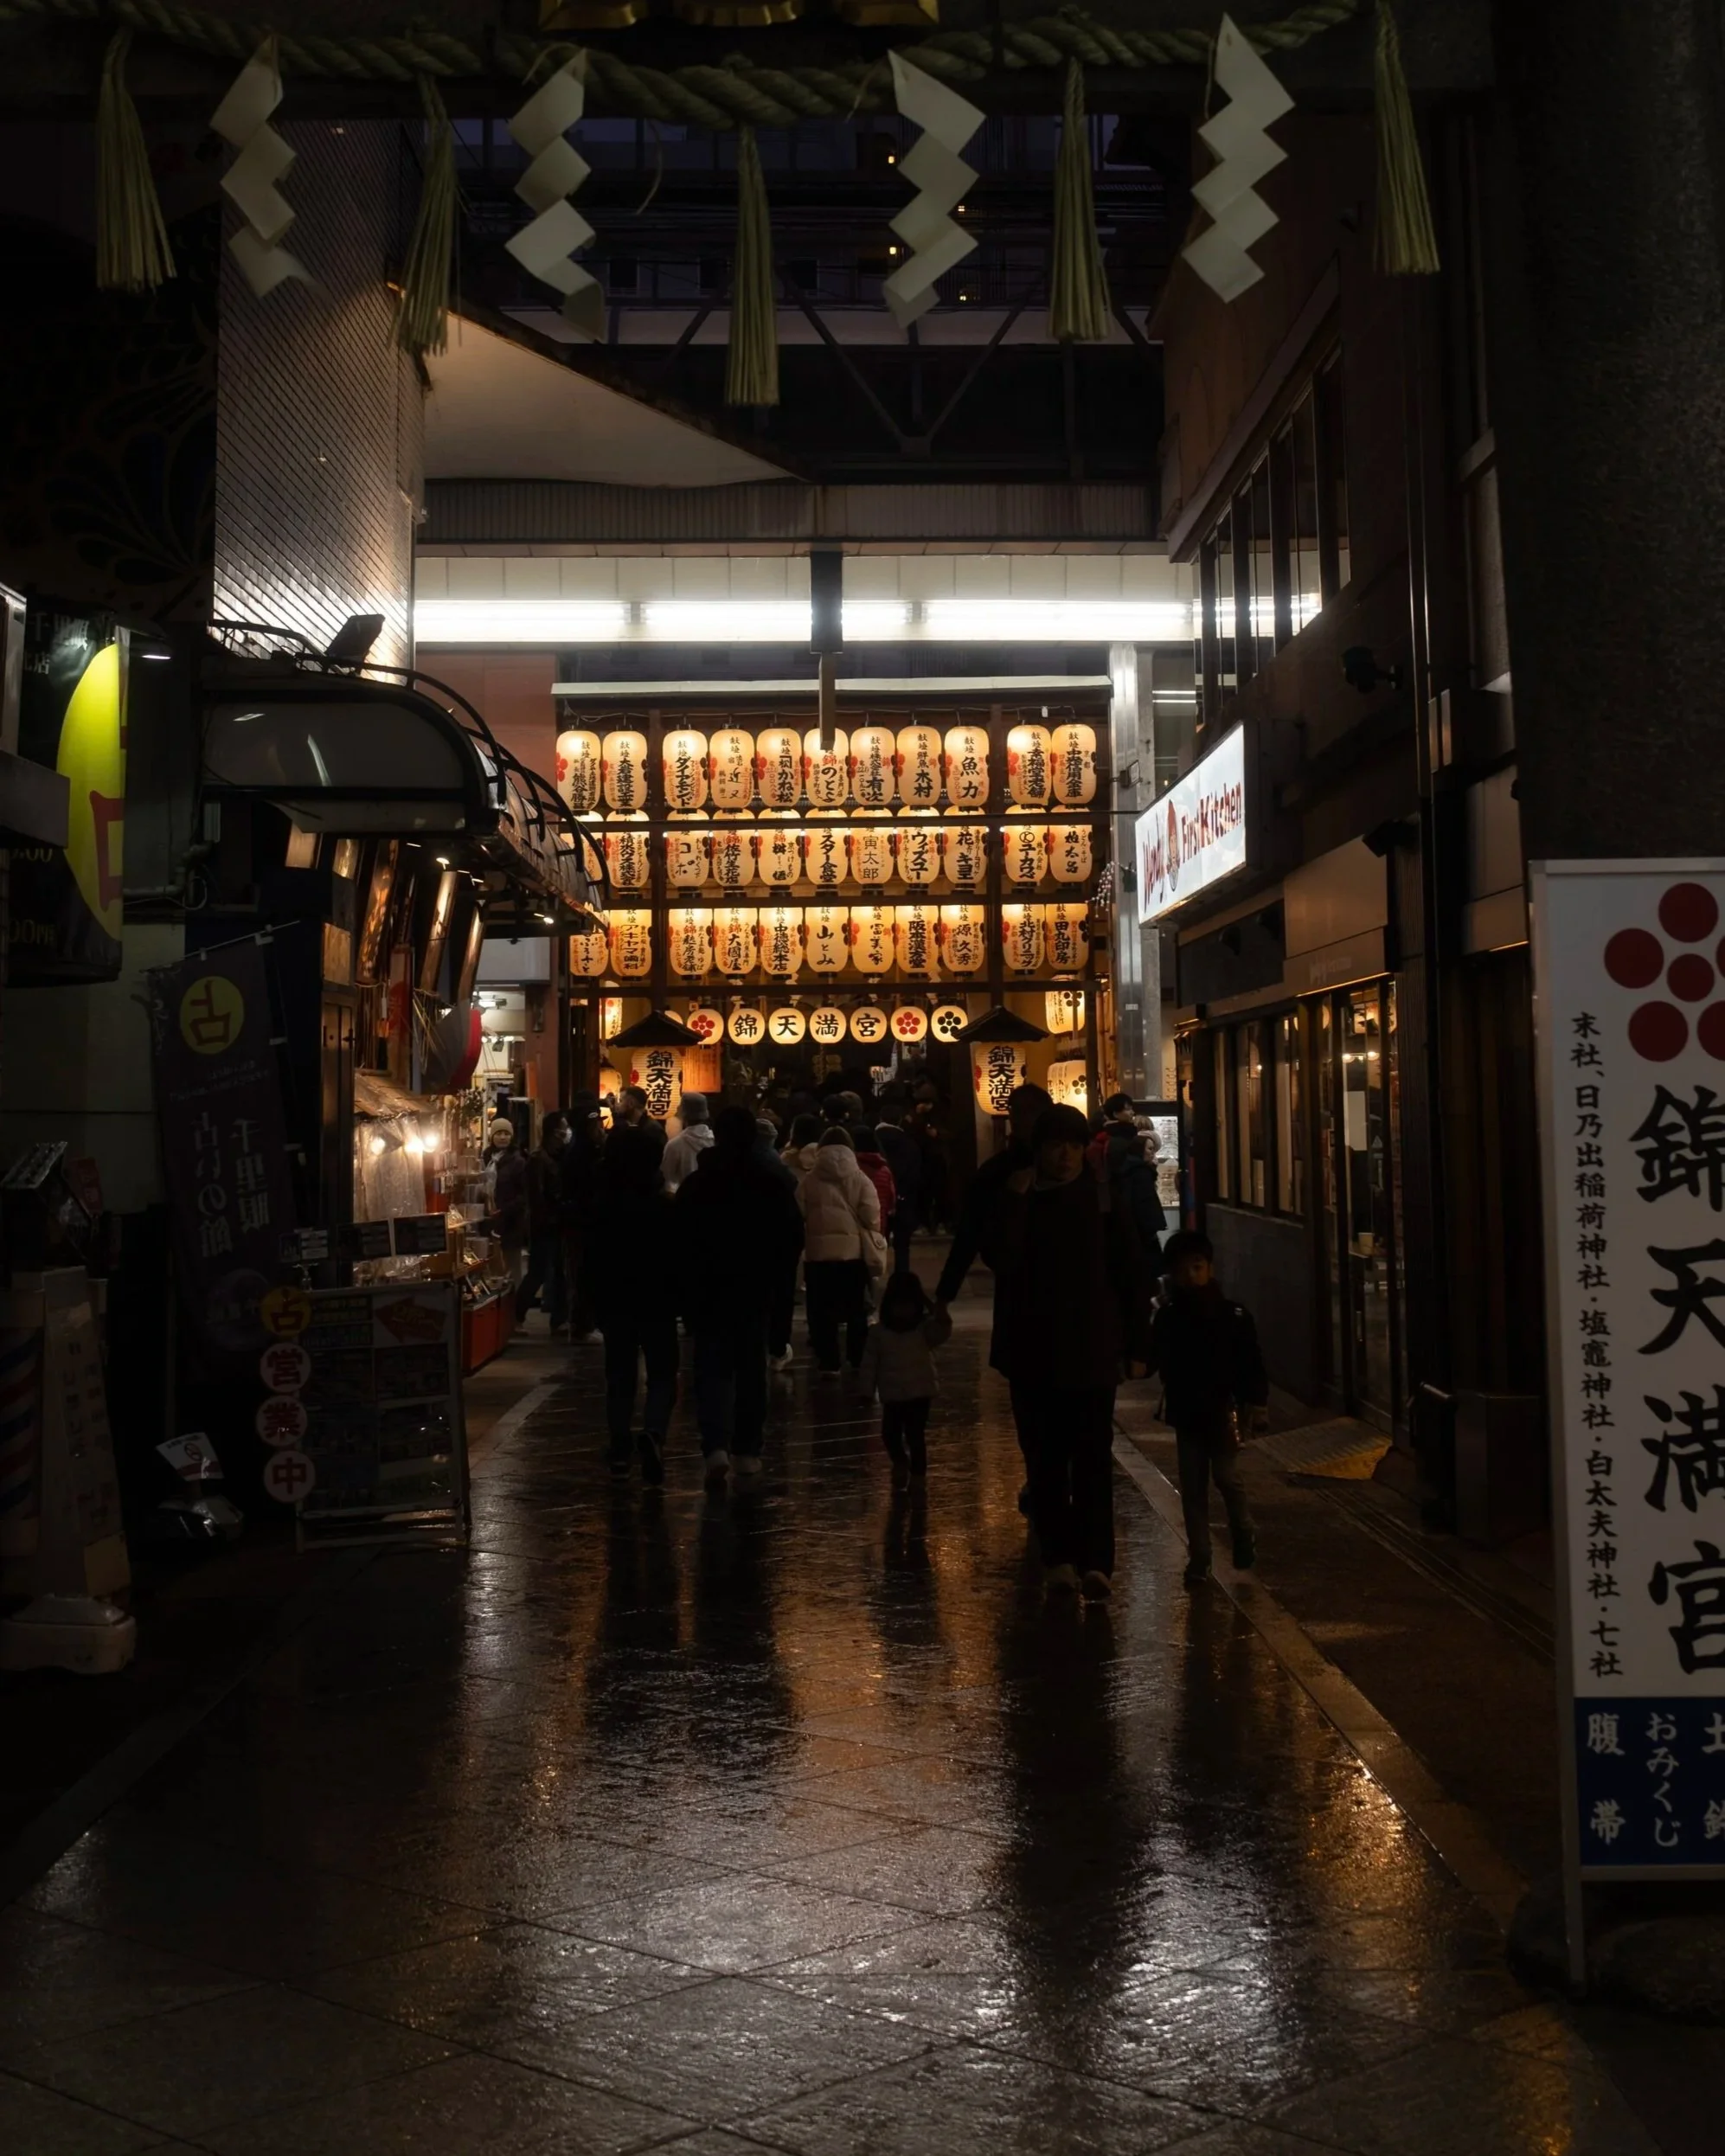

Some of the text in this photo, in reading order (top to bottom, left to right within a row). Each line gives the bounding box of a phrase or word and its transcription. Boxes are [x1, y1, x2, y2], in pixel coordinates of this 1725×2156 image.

[676, 756, 691, 806] ダイヤモンド
[728, 767, 741, 799] 近又
[775, 768, 794, 803] かね松
[821, 767, 837, 803] のとよ
[865, 776, 884, 801] 有次
[914, 769, 933, 798] 木村
[960, 756, 979, 799] 魚力
[820, 835, 837, 882] スター食堂
[862, 835, 879, 880] 寅太郎
[909, 832, 928, 879] ウィズユー
[817, 925, 835, 965] 山とみ
[646, 1049, 674, 1116] 錦天満宮
[988, 1045, 1015, 1111] 錦天満宮
[1627, 1083, 1725, 1676] 錦天満宮
[1587, 1711, 1626, 1845] 腹帯
[1645, 1711, 1682, 1847] おみくじ
